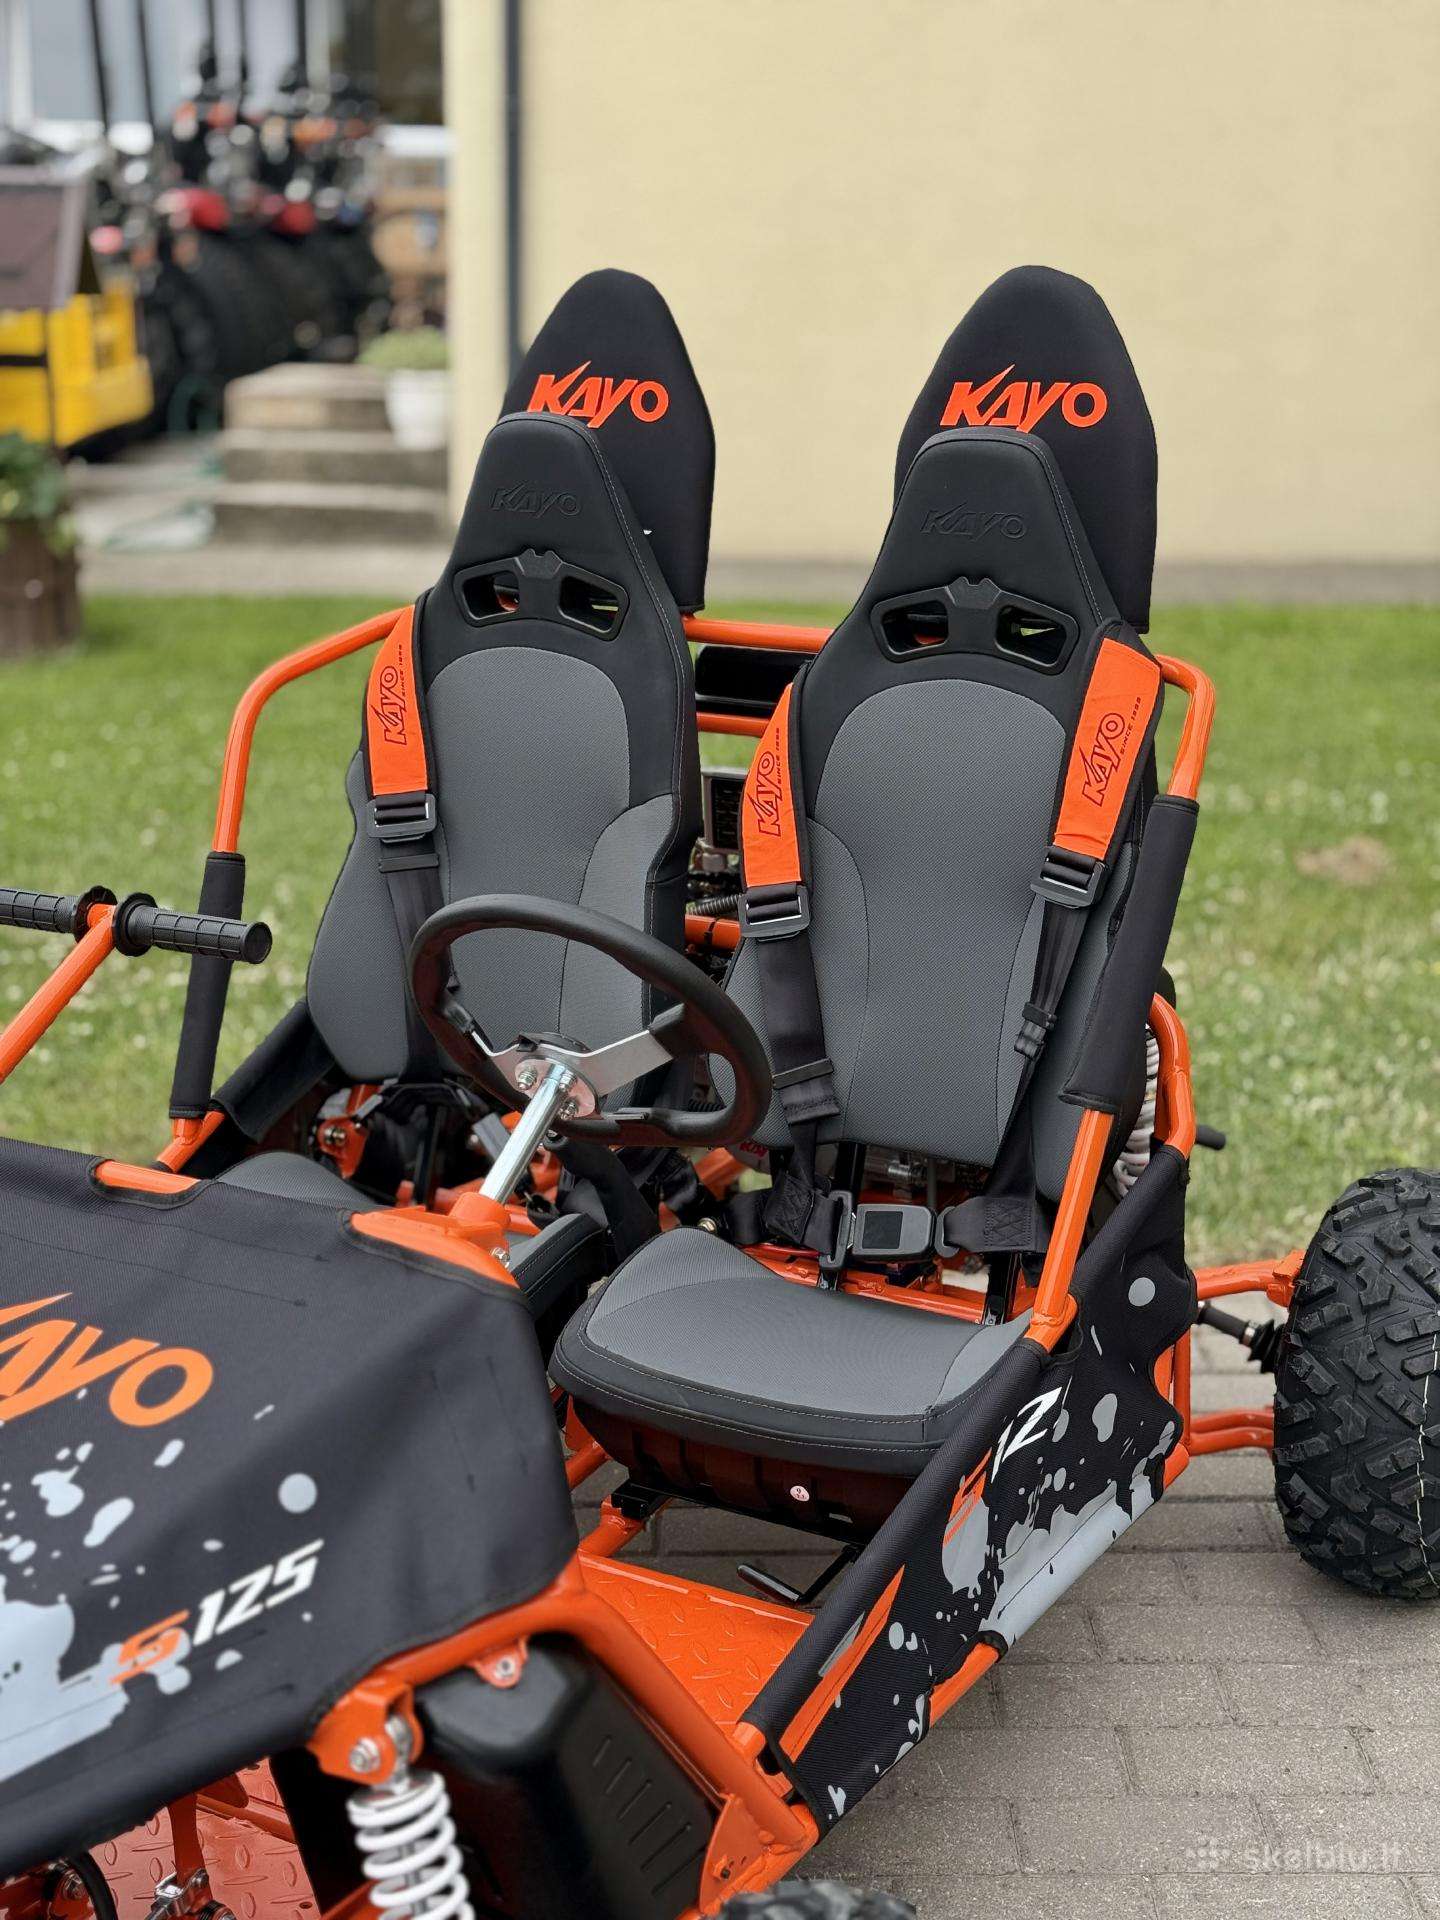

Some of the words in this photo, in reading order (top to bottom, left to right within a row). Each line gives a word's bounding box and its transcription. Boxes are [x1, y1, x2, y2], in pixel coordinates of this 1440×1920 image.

[527, 360, 669, 428] KAYO
[939, 363, 1108, 433] KAYO
[490, 480, 580, 519] KAYO
[919, 500, 1026, 541] KAYO
[371, 665, 407, 746] KAYO
[746, 751, 783, 837] KAYO
[1079, 712, 1126, 808] KAYO
